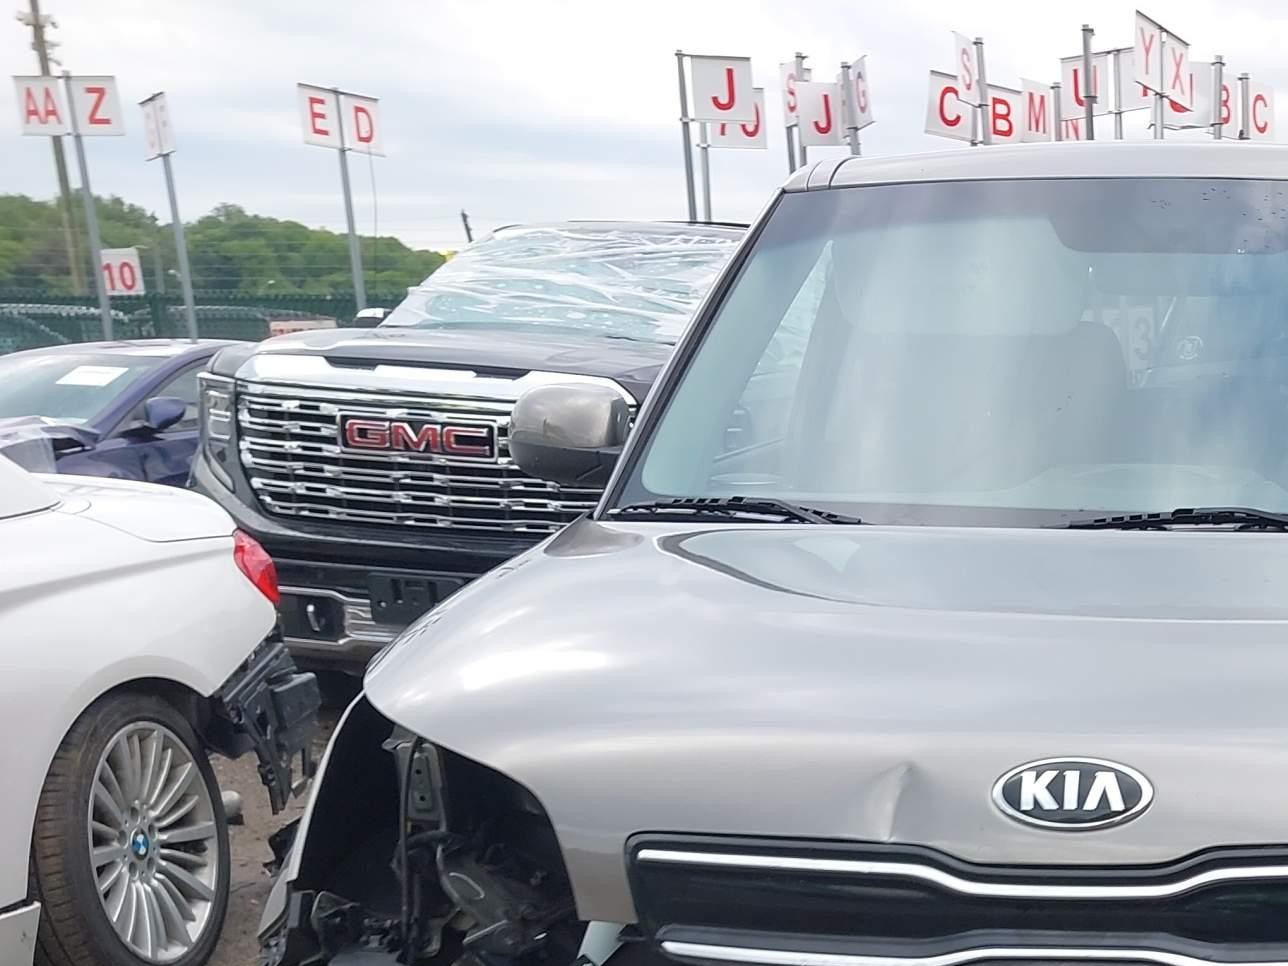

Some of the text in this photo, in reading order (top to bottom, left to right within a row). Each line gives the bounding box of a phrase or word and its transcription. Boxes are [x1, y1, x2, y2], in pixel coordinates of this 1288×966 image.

[1140, 26, 1154, 75] Y
[1171, 47, 1184, 95] X
[25, 86, 63, 124] AA
[84, 87, 112, 124] Z
[711, 67, 735, 111] J
[940, 86, 962, 127] C
[308, 96, 330, 136] E
[354, 105, 373, 143] D
[812, 94, 832, 135] J
[991, 96, 1014, 138] B
[1027, 91, 1046, 135] M
[1253, 94, 1268, 134] C
[103, 261, 136, 290] 10
[345, 419, 490, 456] GMC
[1020, 769, 1126, 812] KIA
